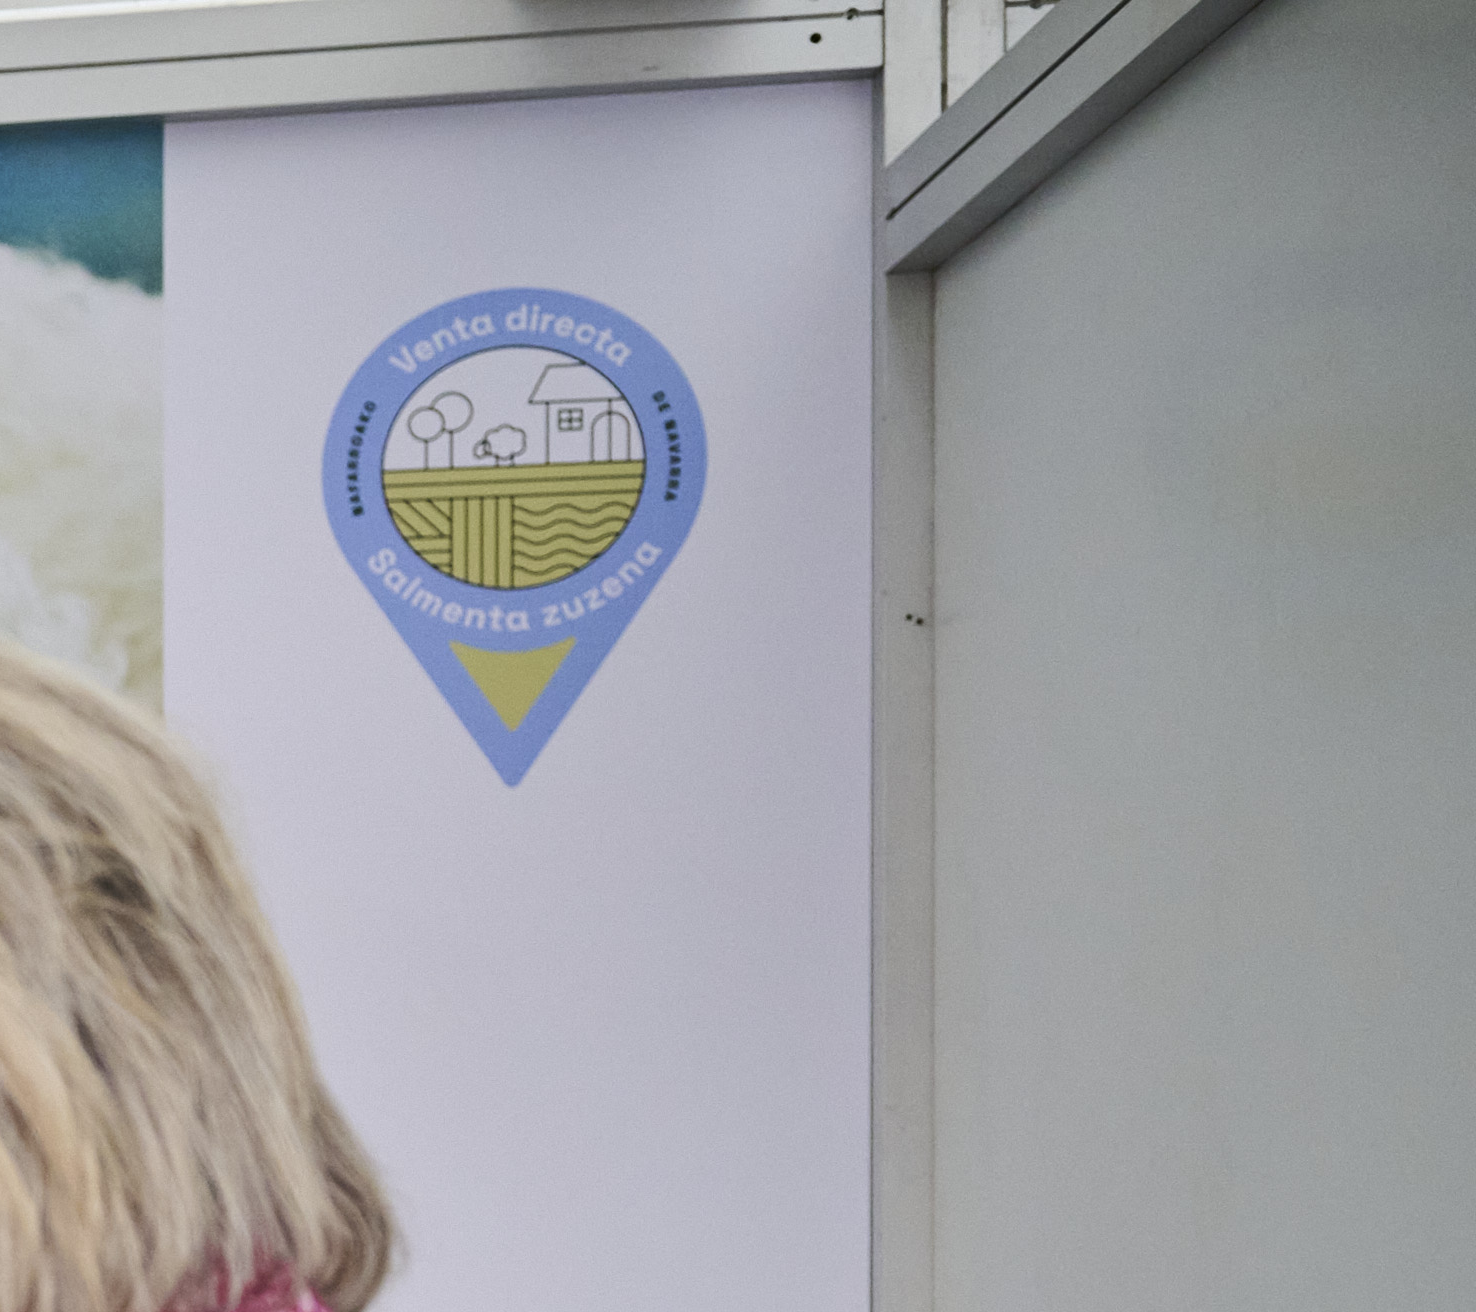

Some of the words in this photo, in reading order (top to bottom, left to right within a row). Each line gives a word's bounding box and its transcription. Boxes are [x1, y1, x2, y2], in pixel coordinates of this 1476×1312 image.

[389, 309, 496, 375] Venta
[506, 304, 632, 367] directa
[368, 549, 530, 631] Salmenta
[543, 542, 662, 626] zuzena
